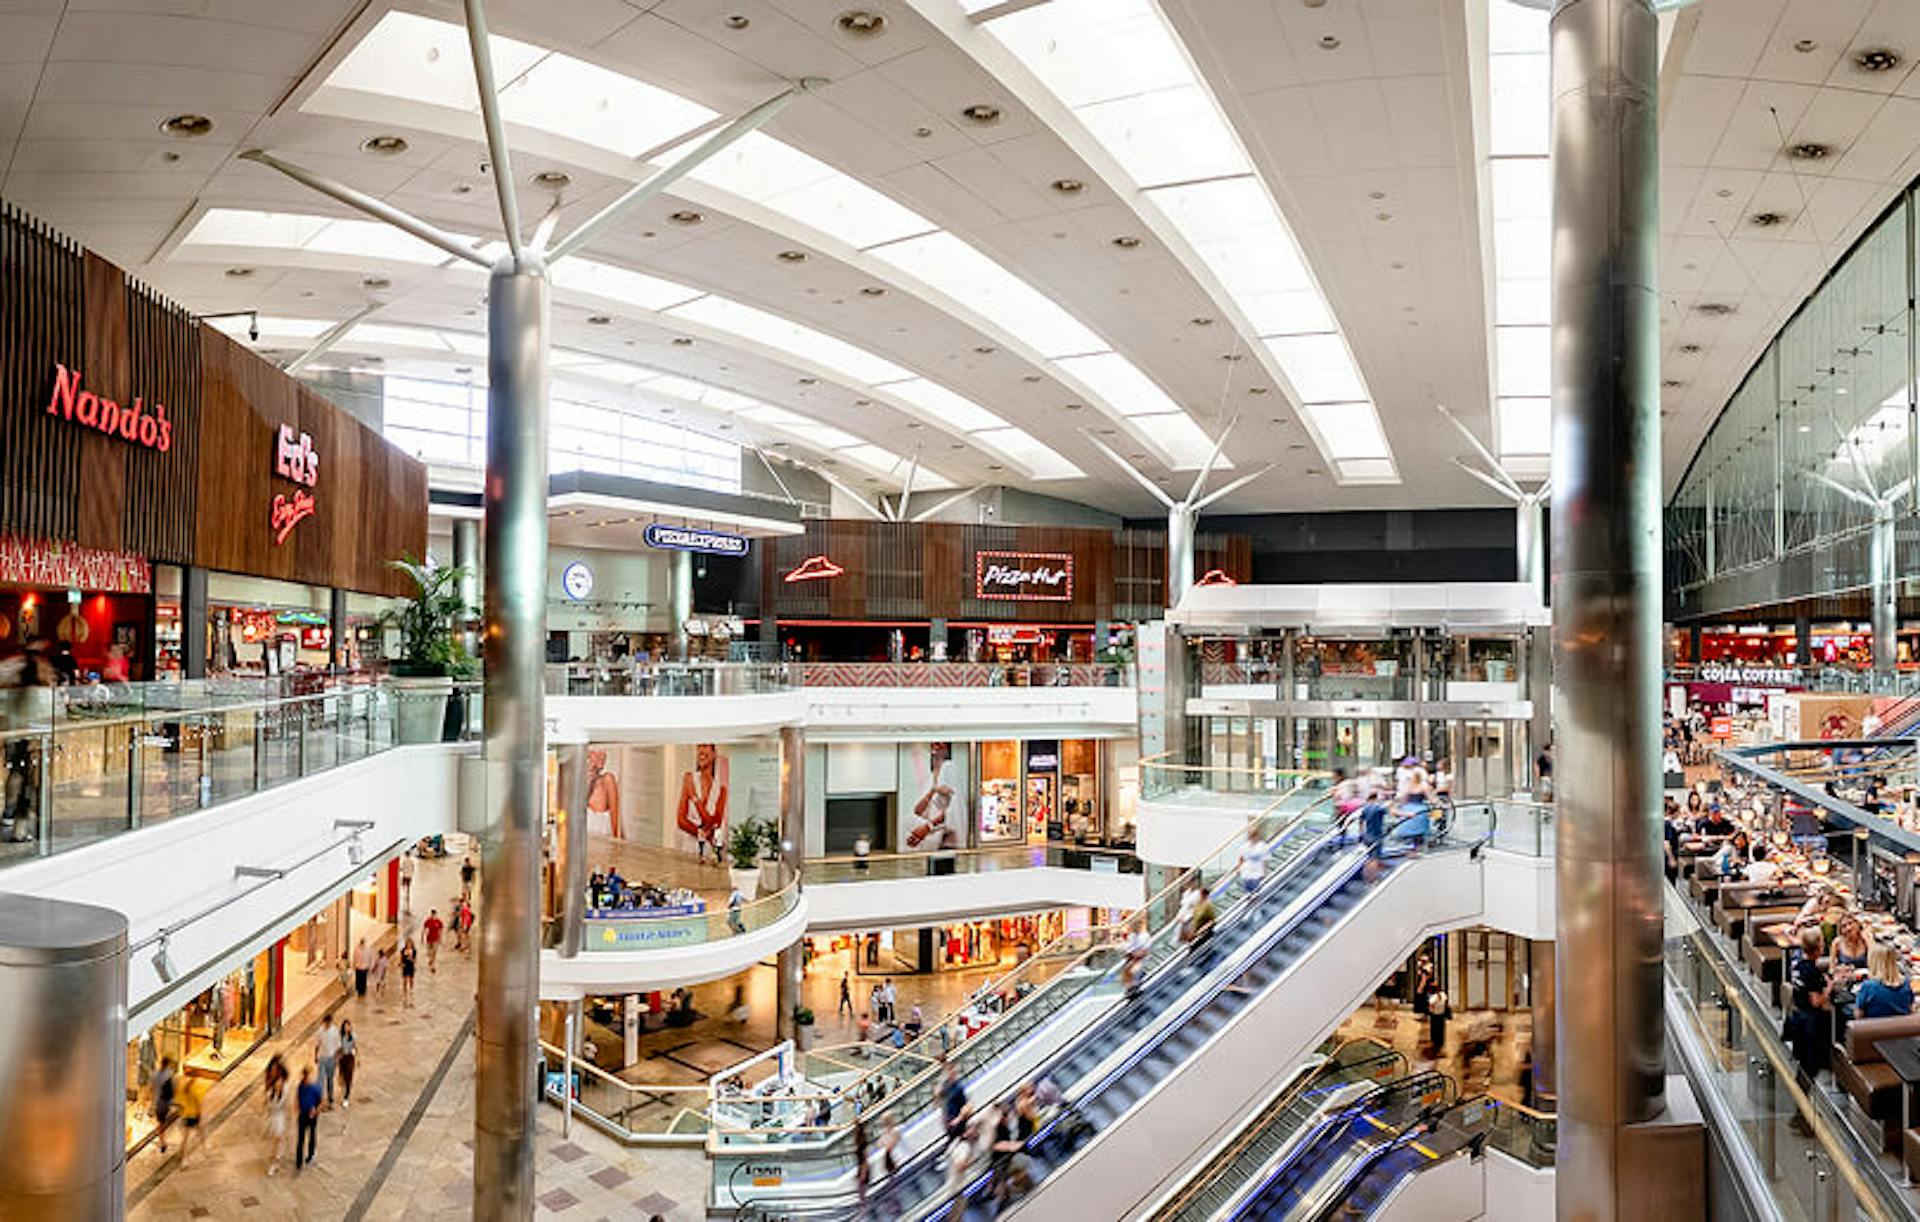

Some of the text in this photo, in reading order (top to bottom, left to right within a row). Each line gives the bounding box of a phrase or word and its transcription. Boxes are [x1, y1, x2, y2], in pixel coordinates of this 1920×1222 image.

[46, 363, 172, 452] Nando's
[278, 423, 319, 488] Ed's
[983, 564, 1066, 586] Pizza Hut
